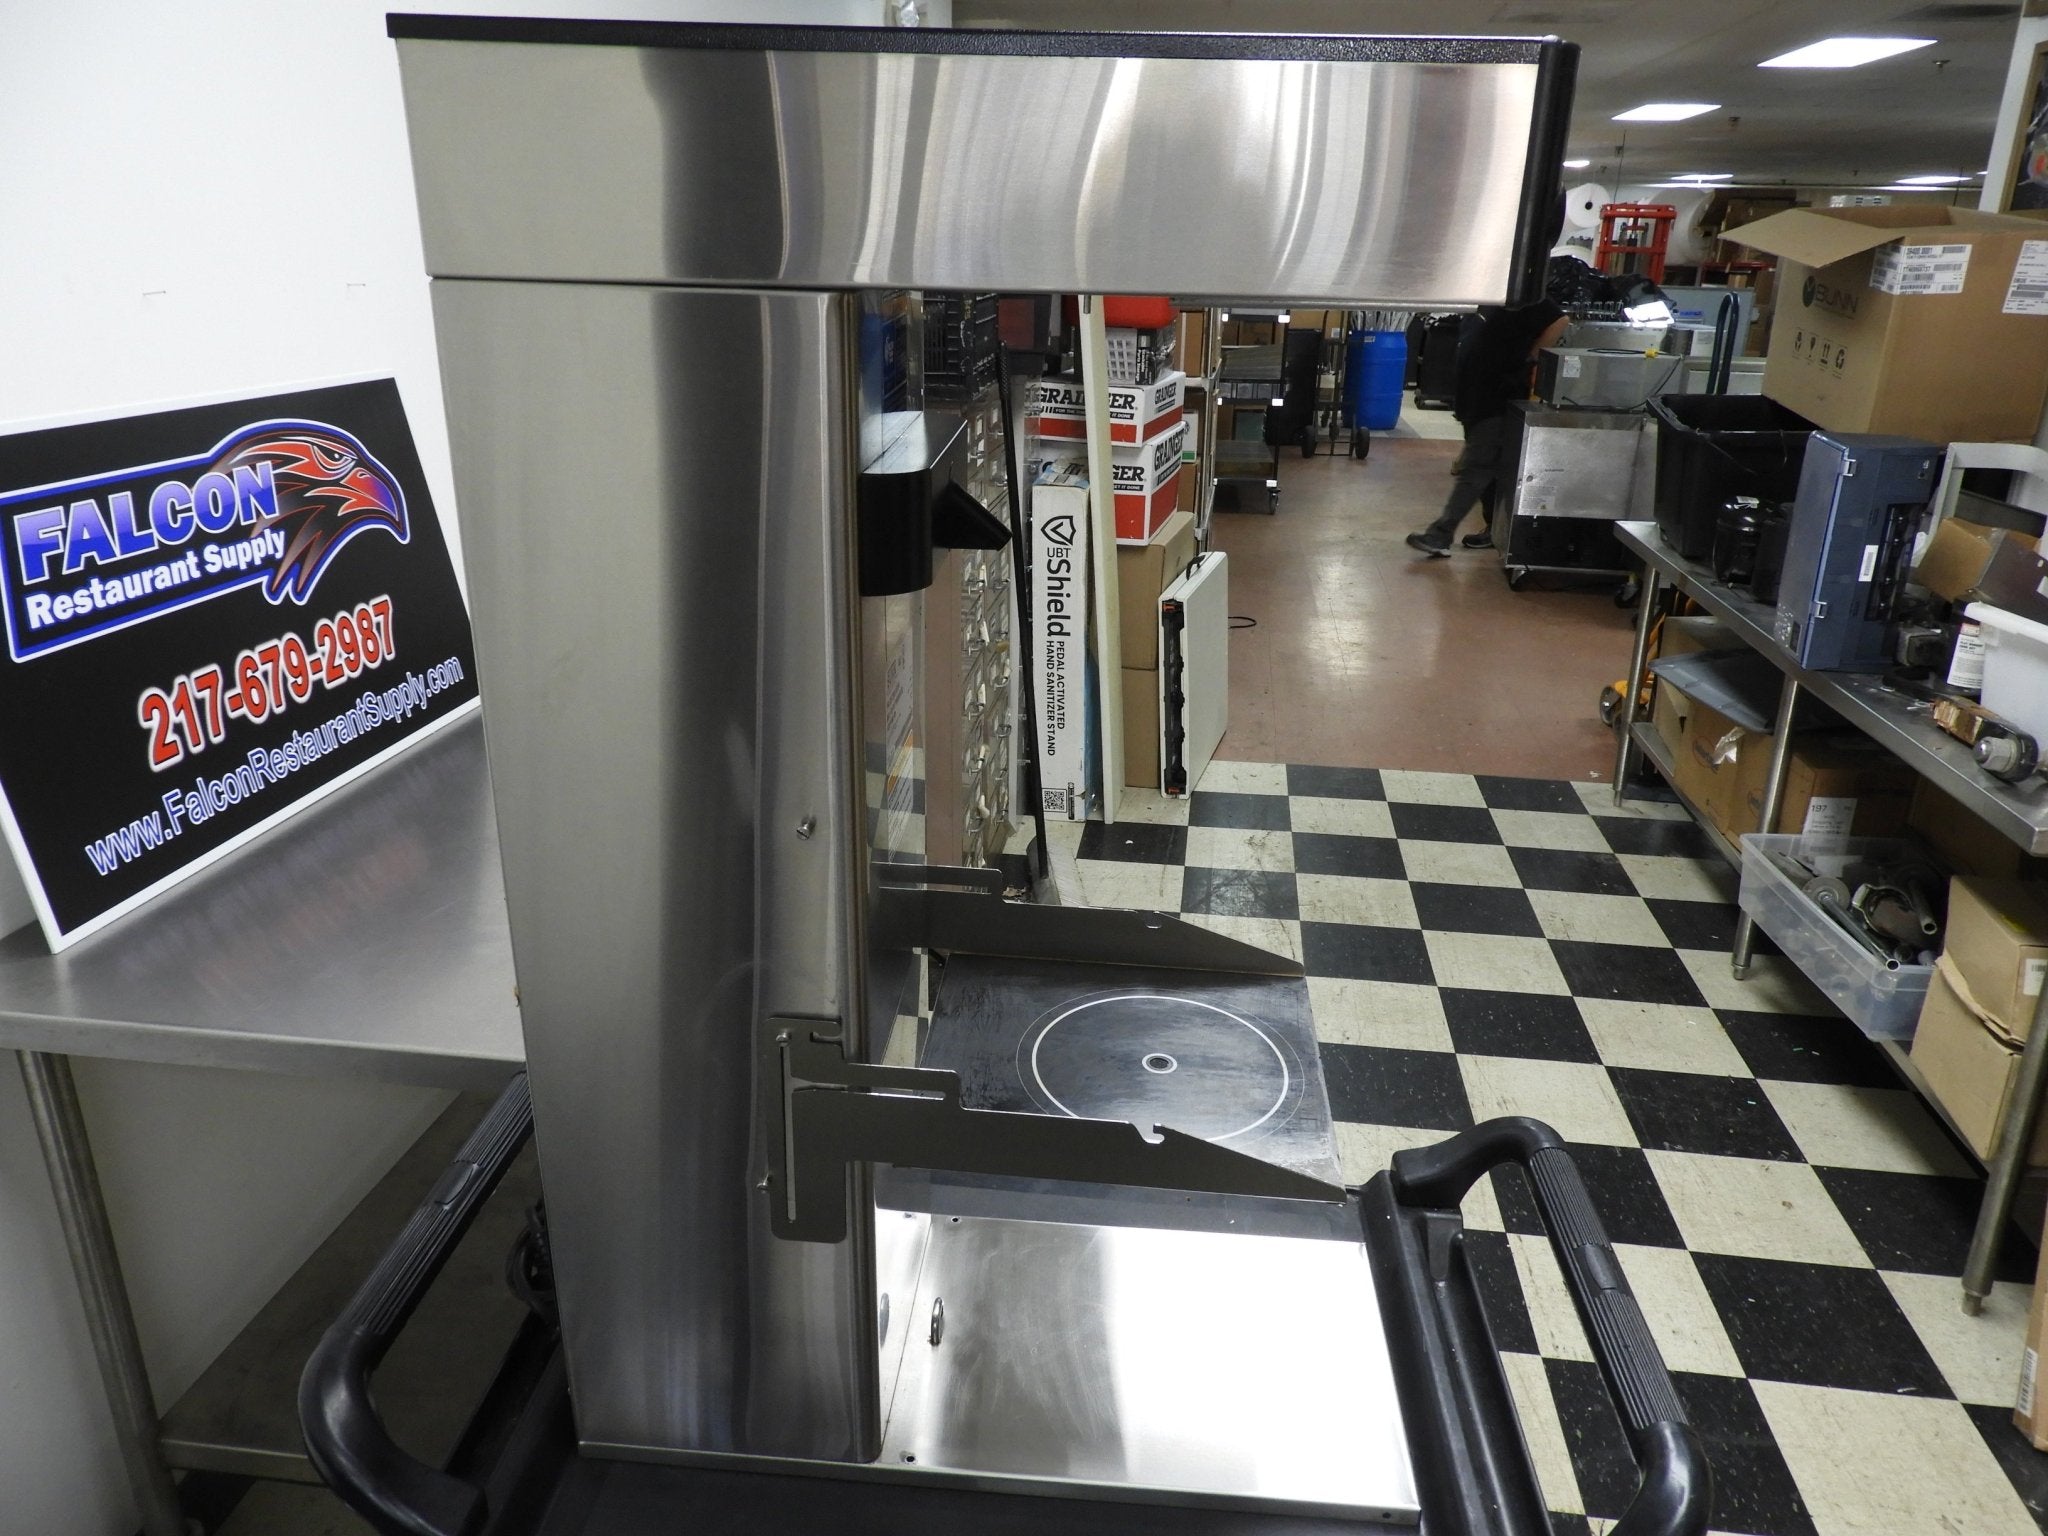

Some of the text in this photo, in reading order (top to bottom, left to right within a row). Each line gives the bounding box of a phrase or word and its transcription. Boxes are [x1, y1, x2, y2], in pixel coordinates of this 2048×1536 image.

[13, 460, 279, 585] FALCON
[1047, 547, 1071, 558] UBT
[25, 527, 285, 629] Restaurant Supply
[1046, 558, 1071, 637] Shield
[140, 597, 394, 770] 217-679-2987
[1046, 640, 1056, 756] HAND SANITIZER STAND
[1056, 641, 1066, 730] PEDAL ACTIVATED
[85, 656, 464, 876] www.FalconRestaurantSupply.com
